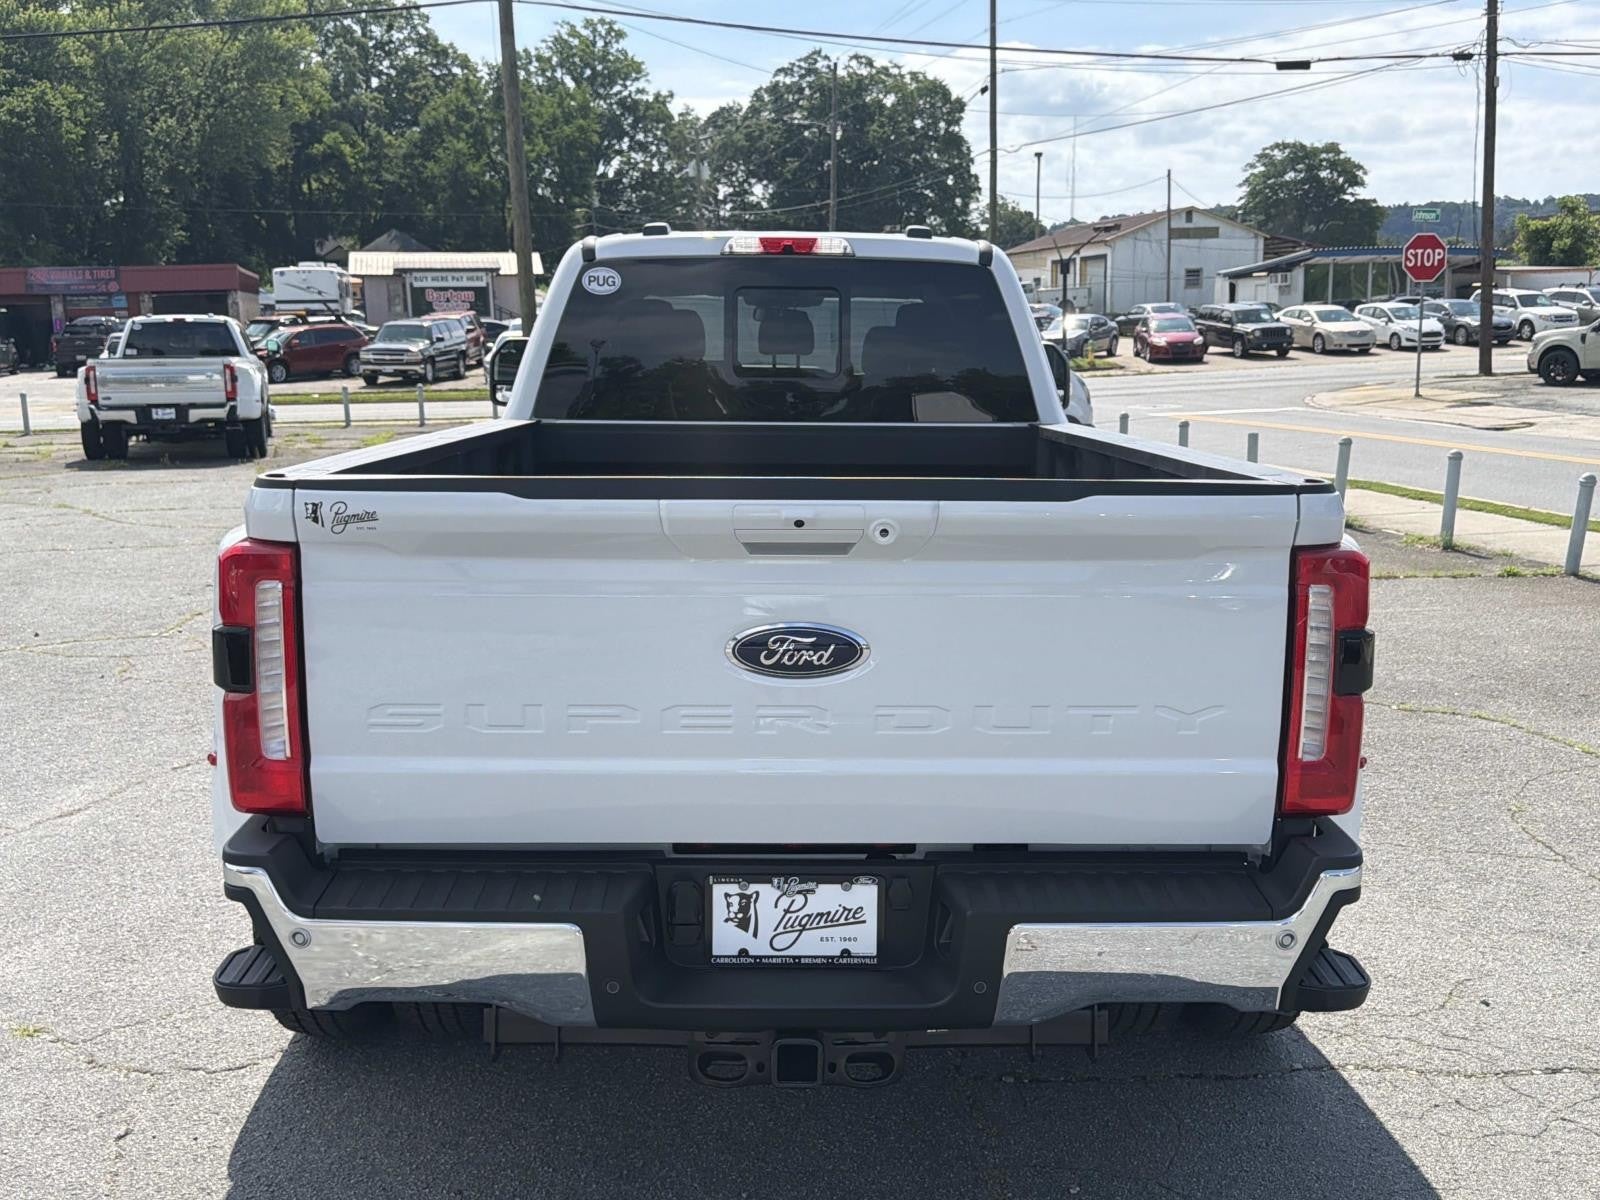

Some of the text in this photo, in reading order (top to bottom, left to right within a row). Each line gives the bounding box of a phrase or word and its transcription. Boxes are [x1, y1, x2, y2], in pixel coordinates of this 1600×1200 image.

[1406, 248, 1444, 267] STOP
[588, 275, 616, 287] PUG
[426, 289, 475, 302] Bartow
[330, 501, 379, 534] Pugmire
[760, 635, 835, 666] Ford
[366, 703, 1227, 735] SUPER DUTY
[769, 893, 866, 951] Pugmire
[711, 957, 878, 965] CARROLLTON MARIETTA BREMEN CARTERSVILLE
